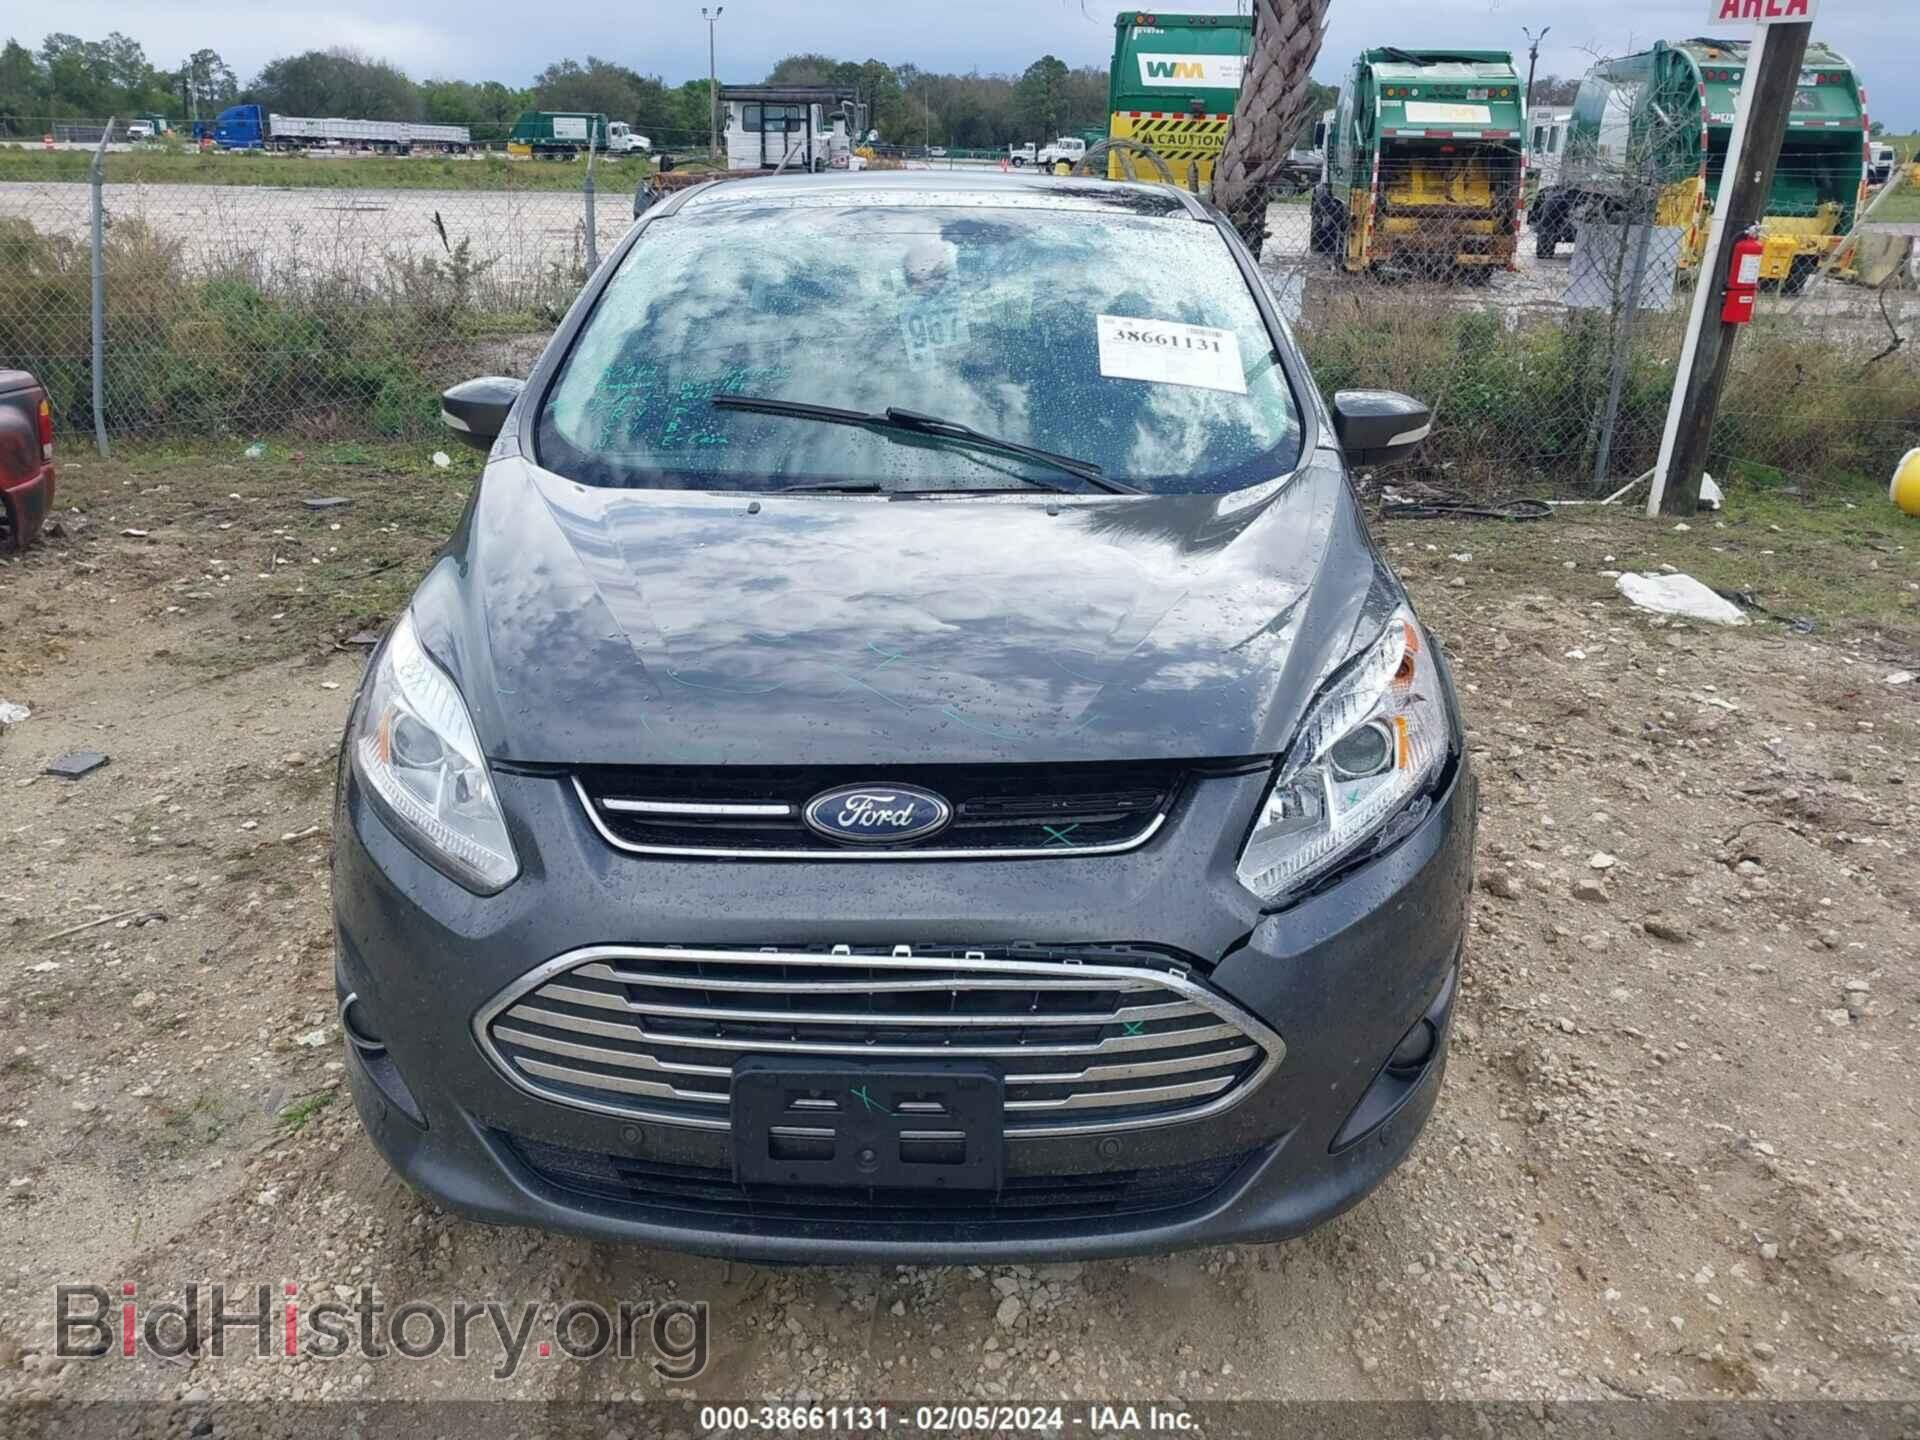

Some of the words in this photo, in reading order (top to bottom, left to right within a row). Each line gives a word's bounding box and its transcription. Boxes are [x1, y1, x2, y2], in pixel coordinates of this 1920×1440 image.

[1146, 61, 1204, 79] WM
[1157, 133, 1224, 146] CAUTION
[1112, 328, 1220, 353] 38661131
[837, 794, 915, 827] Ford
